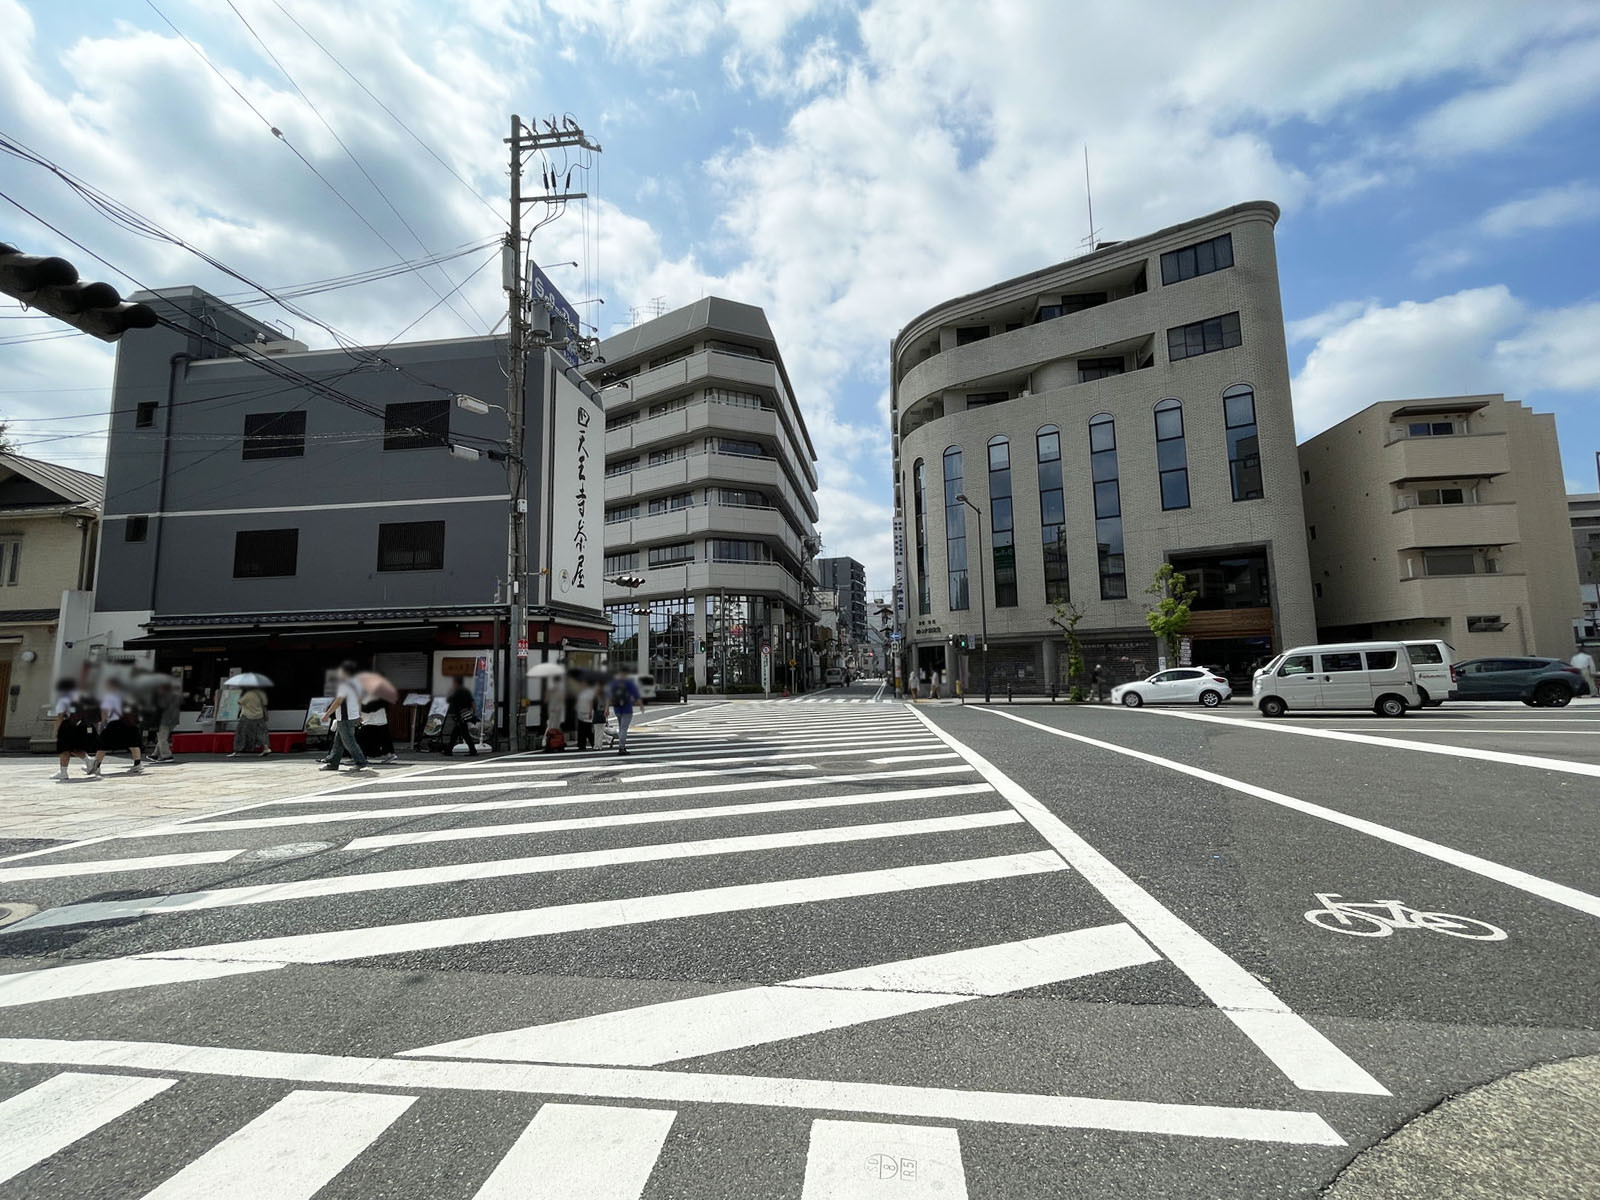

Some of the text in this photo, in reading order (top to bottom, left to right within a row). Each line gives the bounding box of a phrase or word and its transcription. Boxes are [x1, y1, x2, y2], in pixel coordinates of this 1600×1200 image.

[572, 406, 590, 588] 四天王寺茶屋
